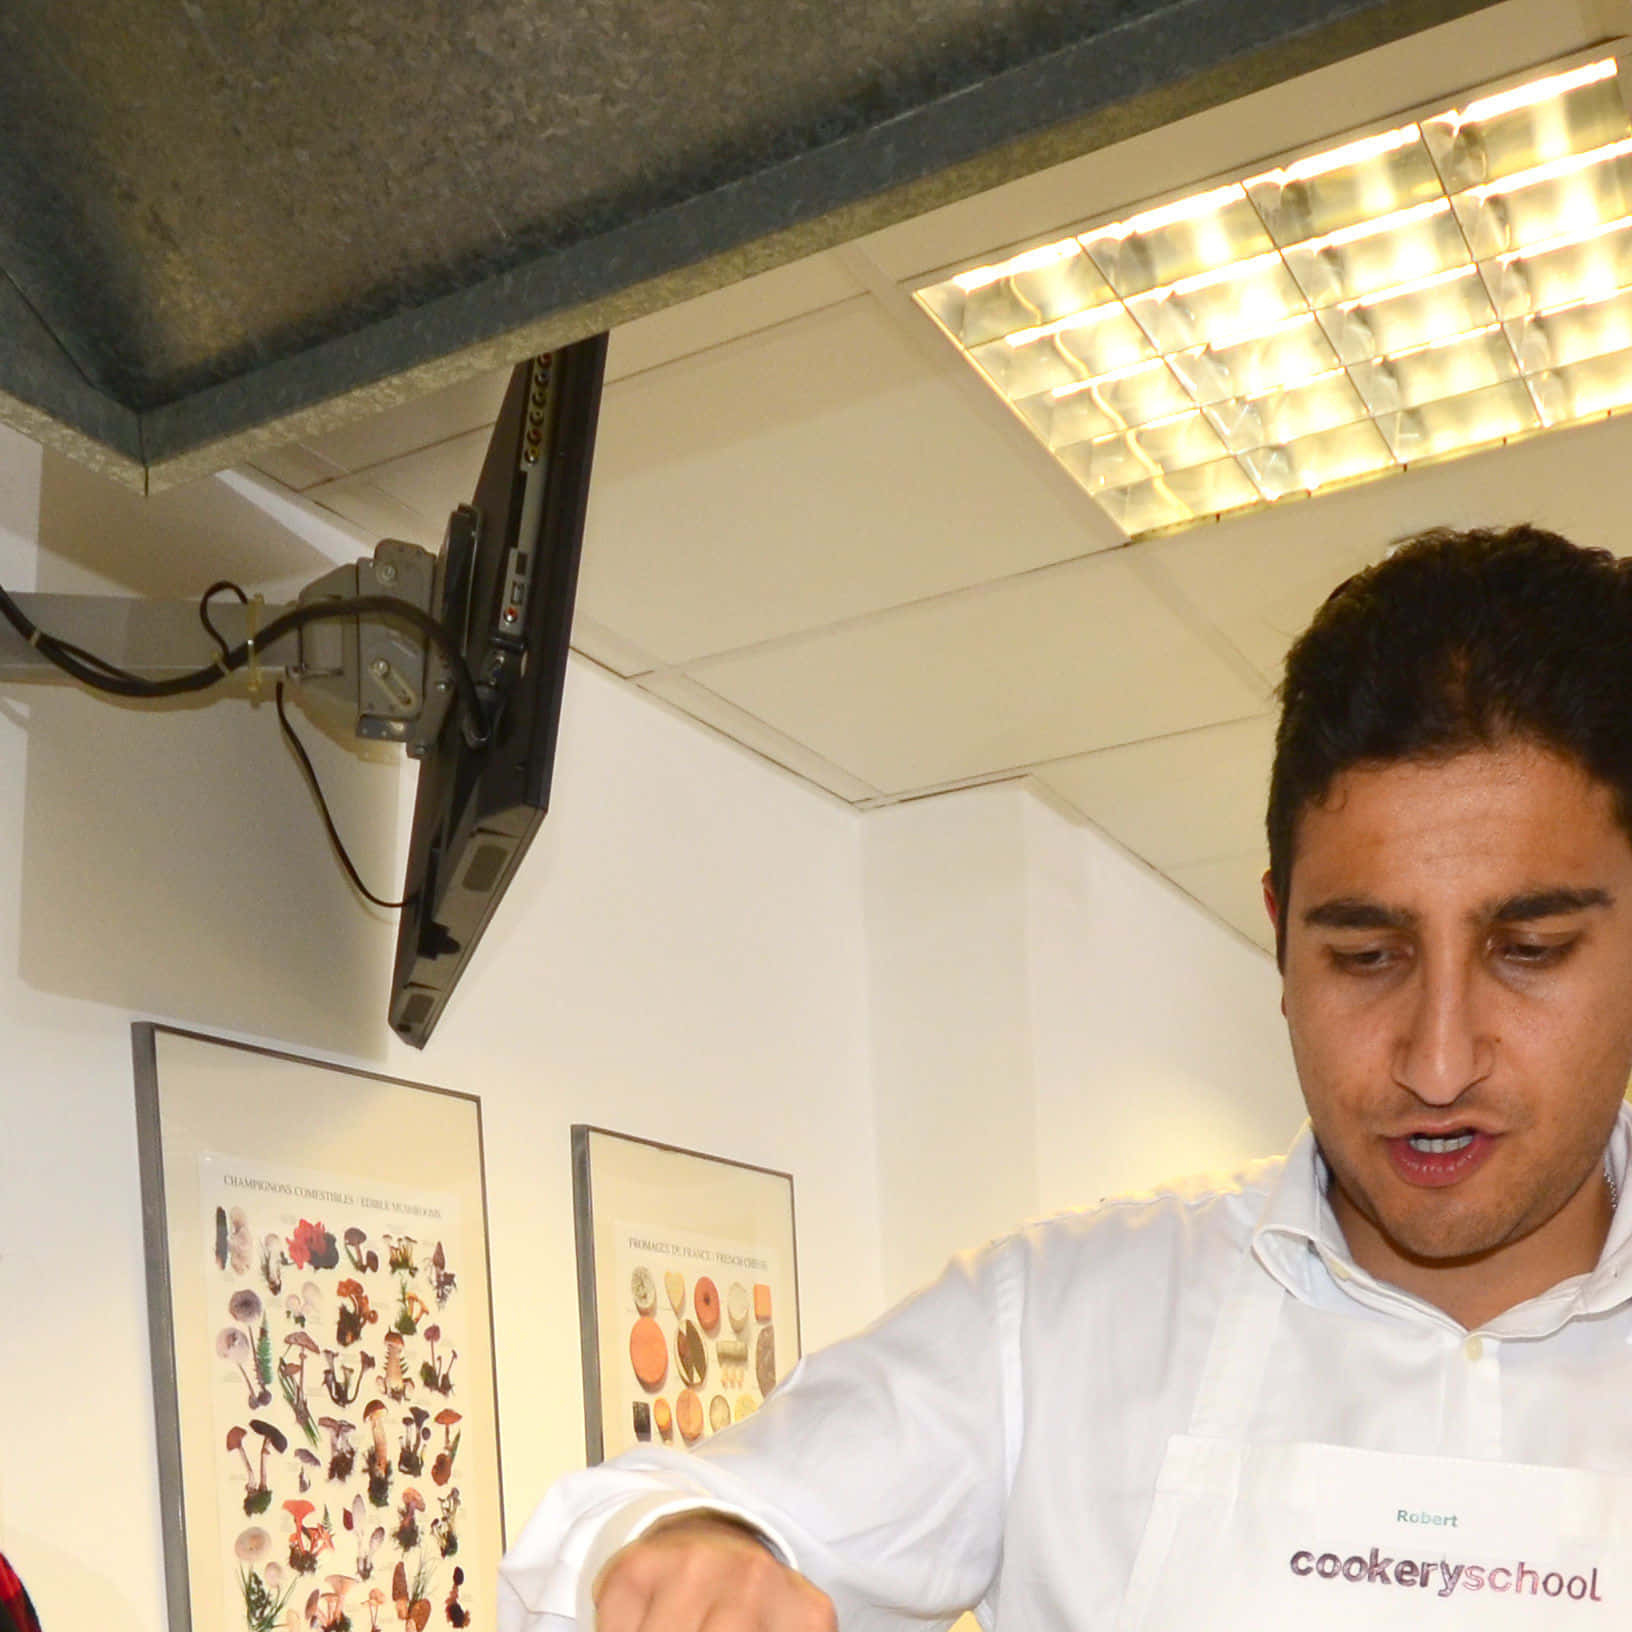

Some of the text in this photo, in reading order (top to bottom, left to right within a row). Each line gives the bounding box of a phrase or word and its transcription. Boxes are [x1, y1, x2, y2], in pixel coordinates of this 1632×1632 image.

[224, 1174, 293, 1196] CHAMPIGNONS
[1396, 1509, 1458, 1528] Robert
[1290, 1547, 1602, 1601] cookeryschool
